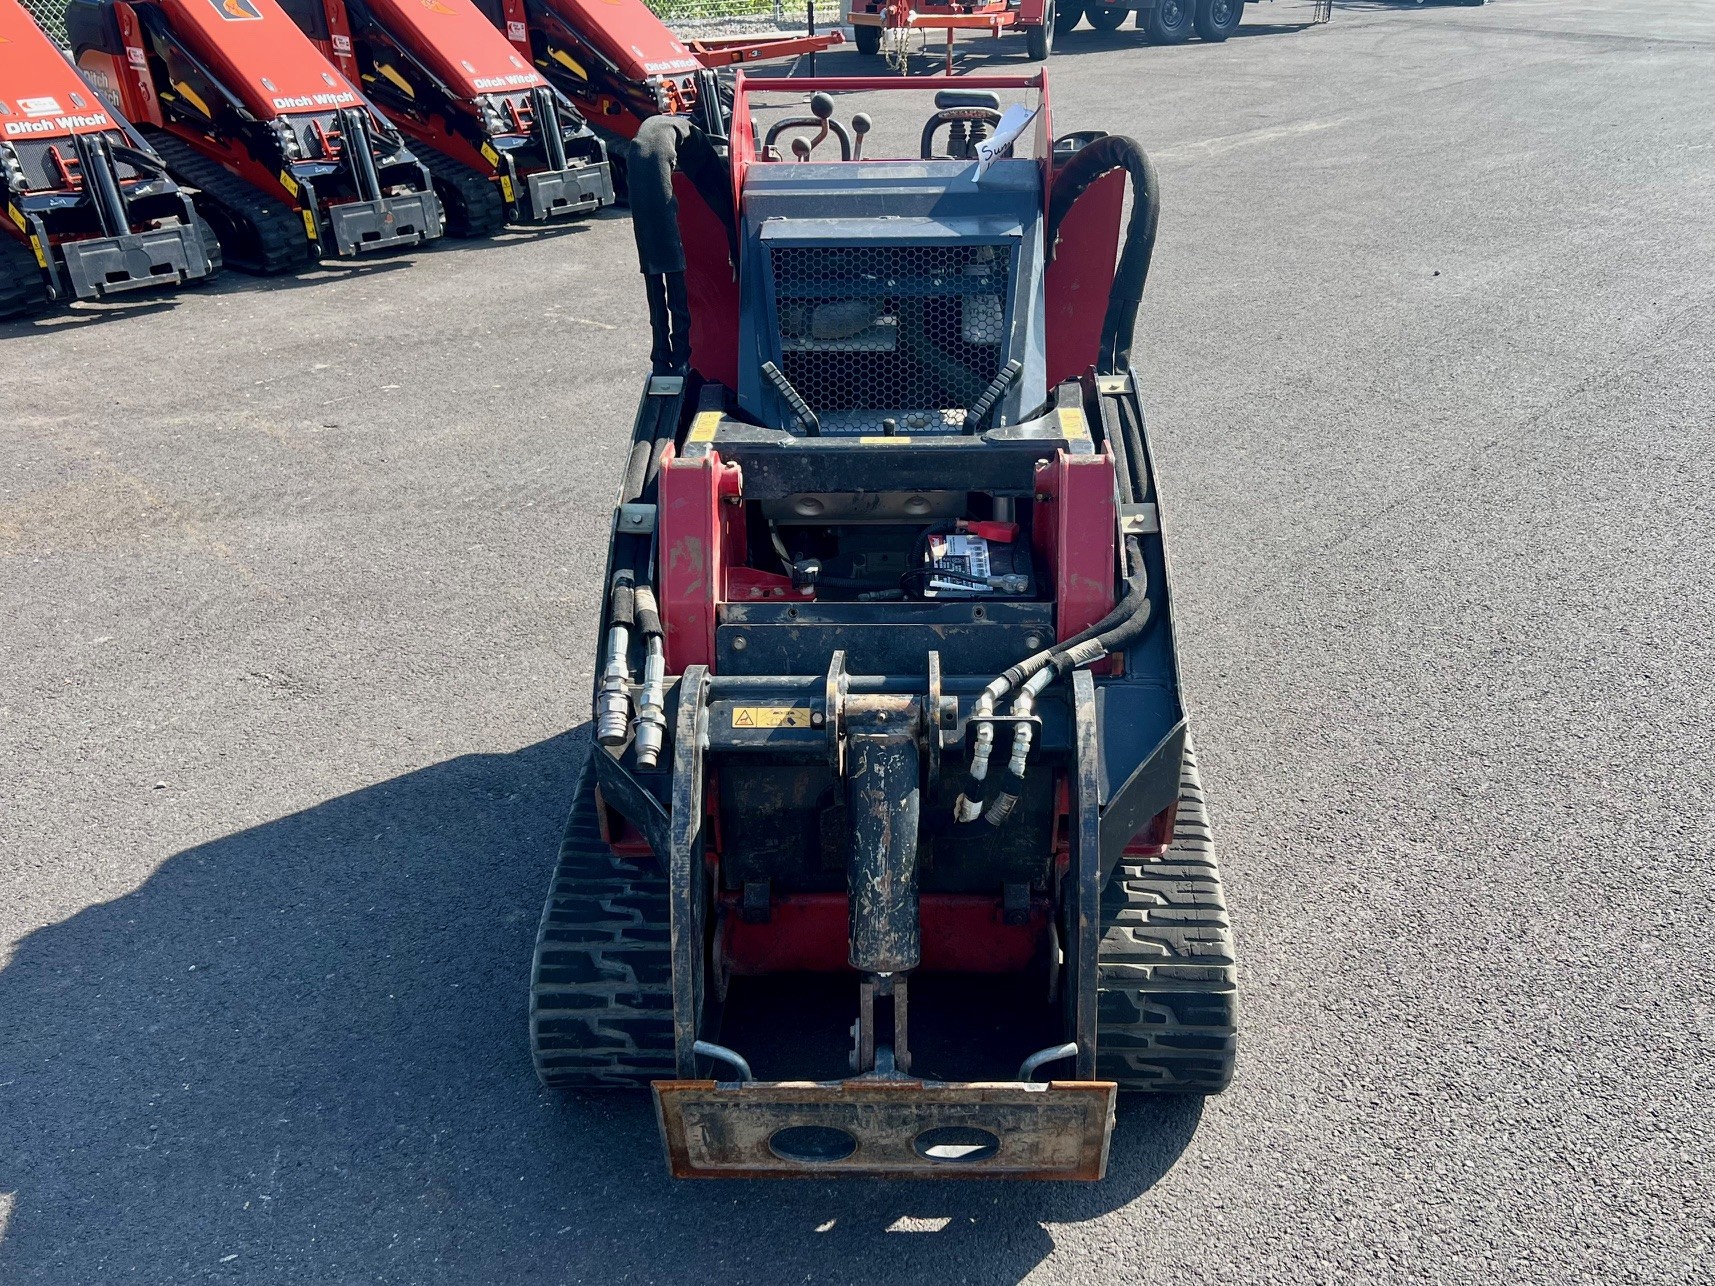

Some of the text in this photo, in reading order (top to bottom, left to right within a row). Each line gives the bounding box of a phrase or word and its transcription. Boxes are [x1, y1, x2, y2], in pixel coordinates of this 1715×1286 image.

[644, 57, 697, 71] Ditch Witch
[473, 73, 538, 88] Ditch Witch
[273, 91, 355, 108] Ditch Witch
[5, 113, 107, 135] Ditch Witch
